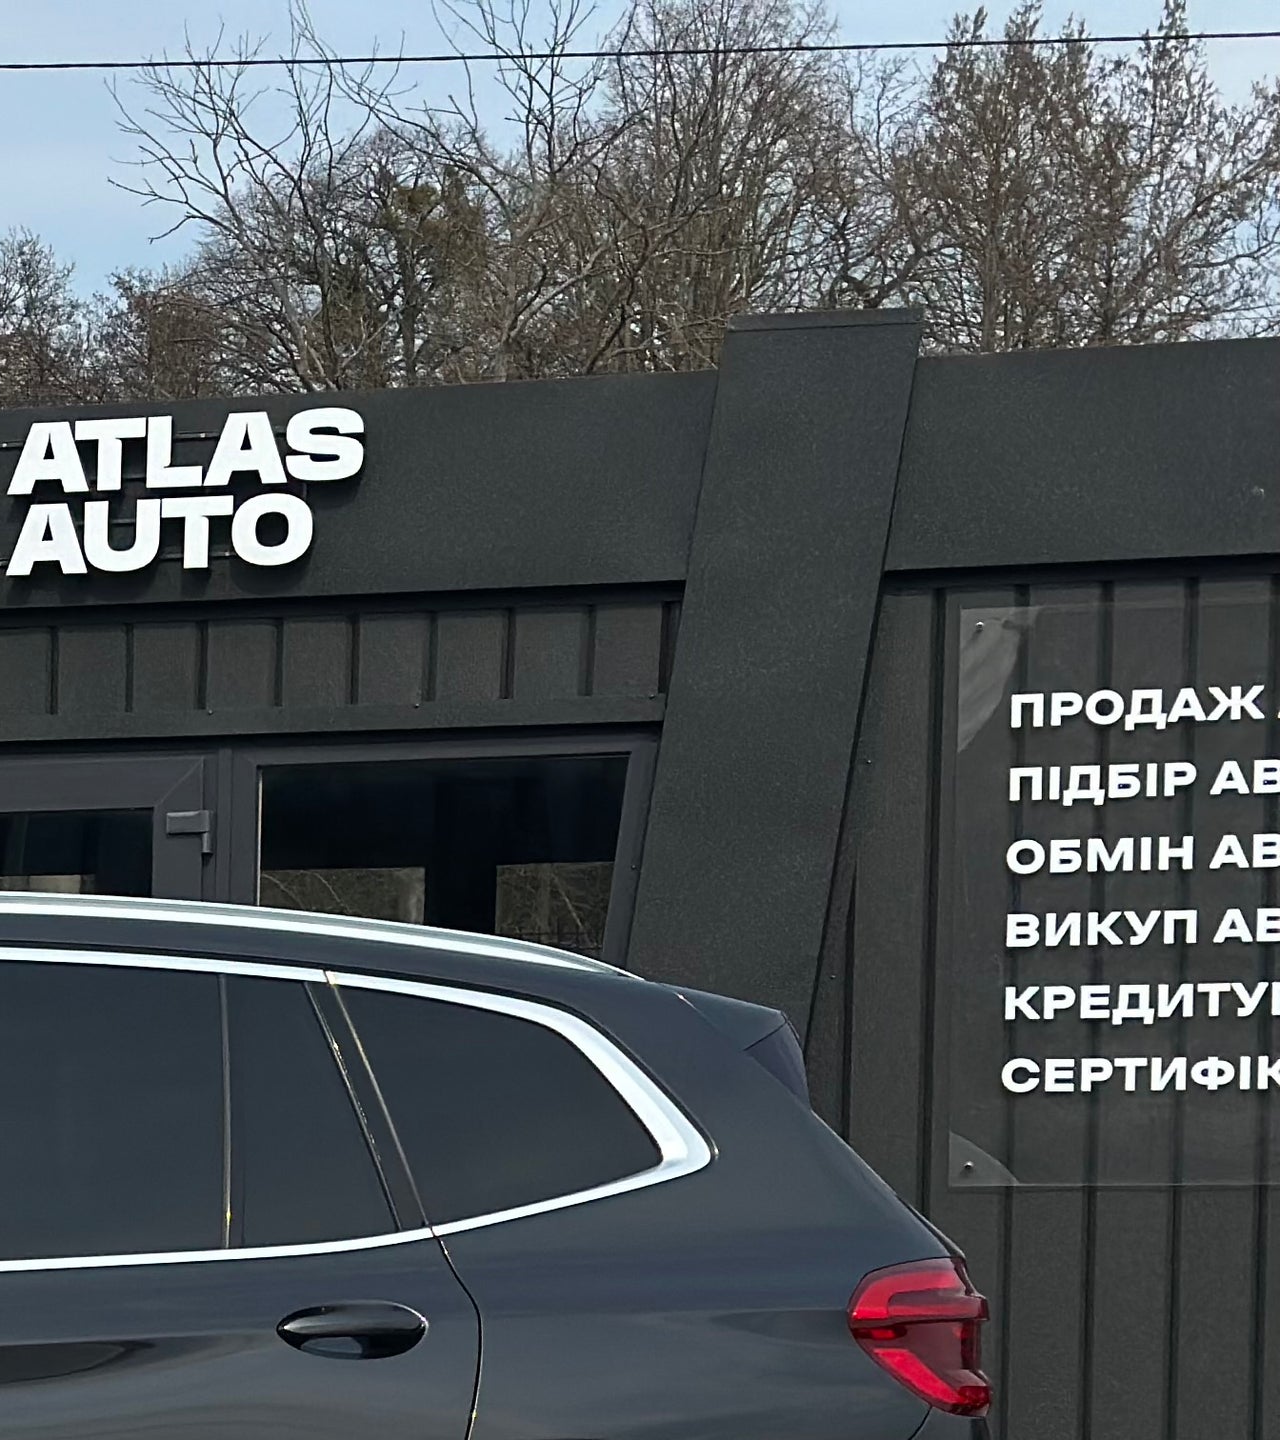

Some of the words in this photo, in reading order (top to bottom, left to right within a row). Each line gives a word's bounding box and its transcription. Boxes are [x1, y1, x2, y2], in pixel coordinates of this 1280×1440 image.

[6, 407, 365, 495] ATLAS
[5, 494, 313, 576] AUTO
[1010, 684, 1266, 731] ПРОДАЖ
[1009, 761, 1197, 807] ПІДБІР
[1006, 835, 1194, 875] ОБМІН
[1005, 909, 1198, 948] ВИКУП
[1004, 981, 1280, 1026] КРЕДИТУ
